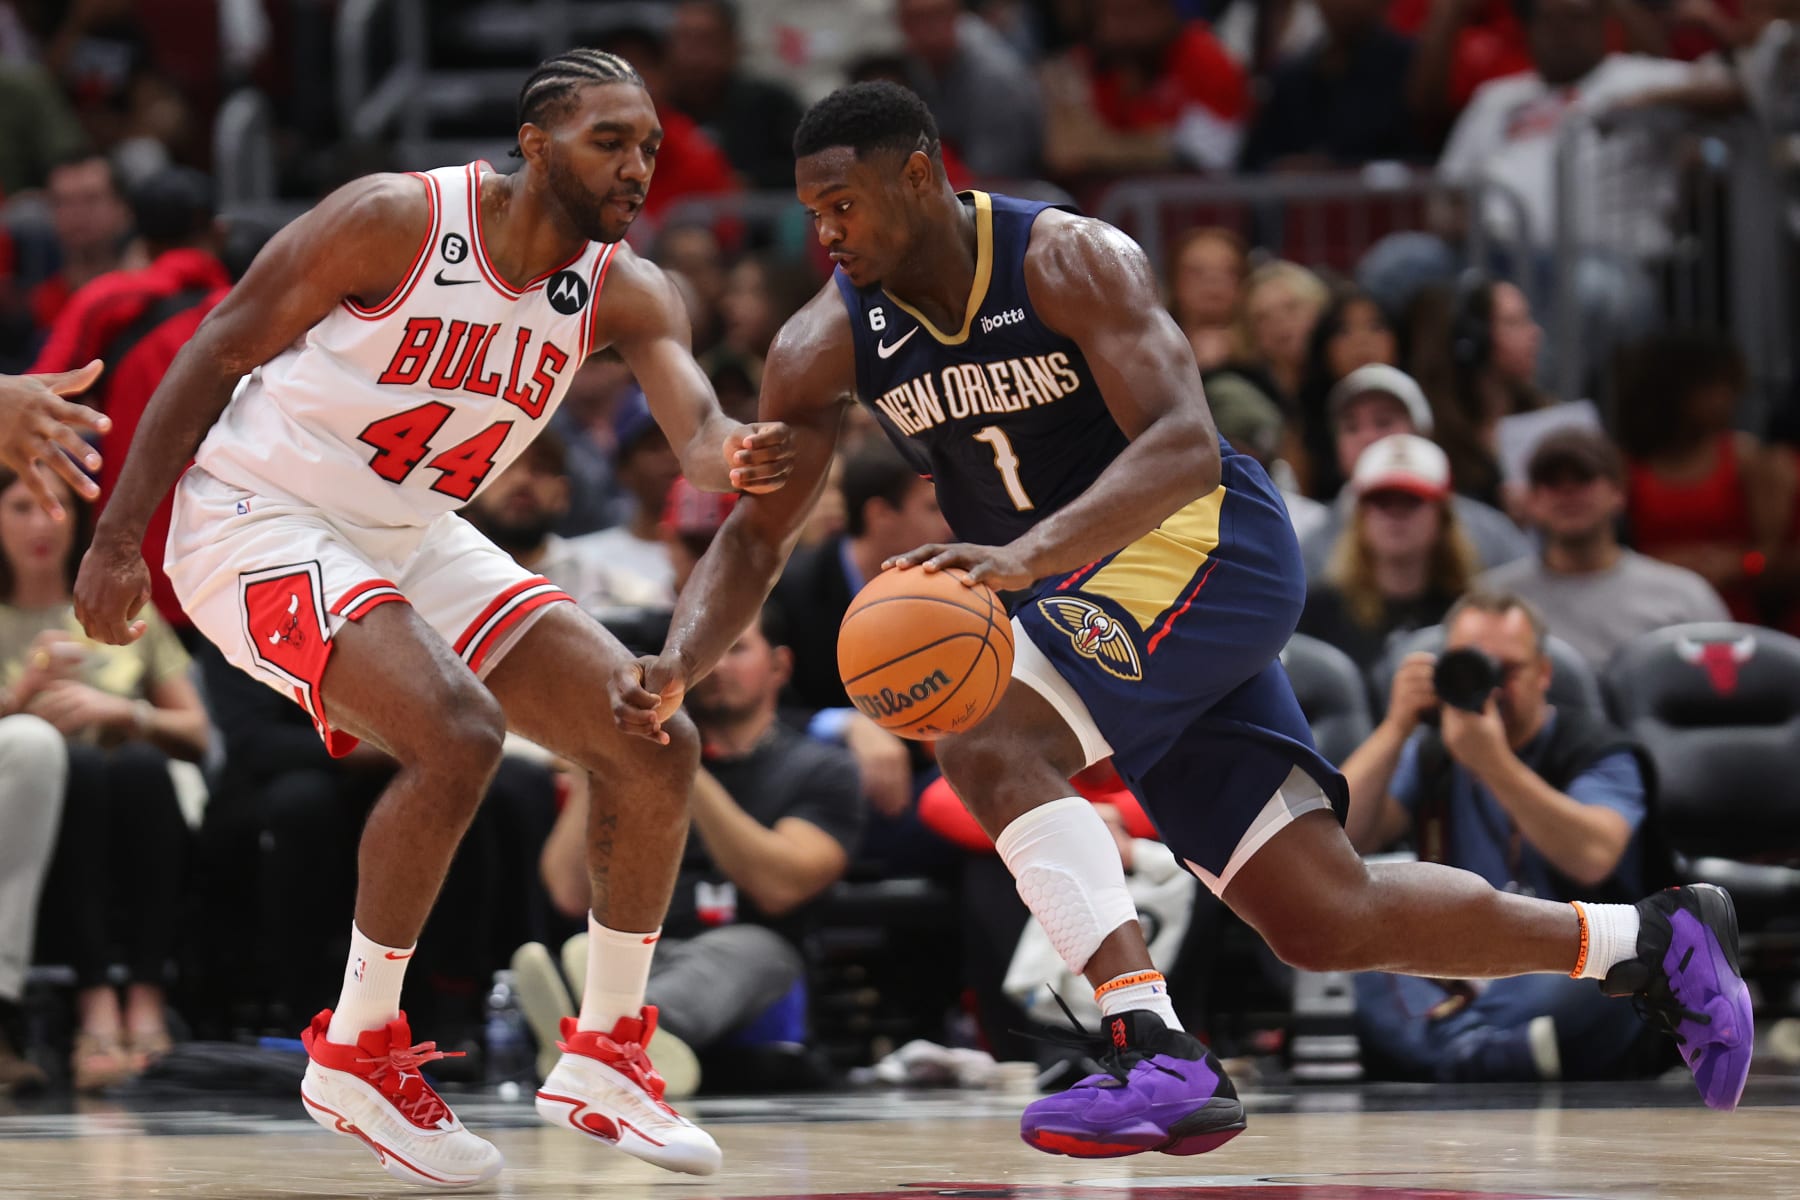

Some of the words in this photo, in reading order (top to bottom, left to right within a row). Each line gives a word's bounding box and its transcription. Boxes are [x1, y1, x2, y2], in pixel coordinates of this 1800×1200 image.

[444, 237, 464, 262] 6
[868, 307, 886, 331] 6
[980, 307, 1026, 334] ibotta
[377, 316, 570, 421] BULLS
[874, 371, 947, 437] NEW
[941, 351, 1081, 420] ORLEANS
[357, 400, 515, 502] 44
[972, 425, 1035, 512] 1
[852, 669, 953, 719] Wilson
